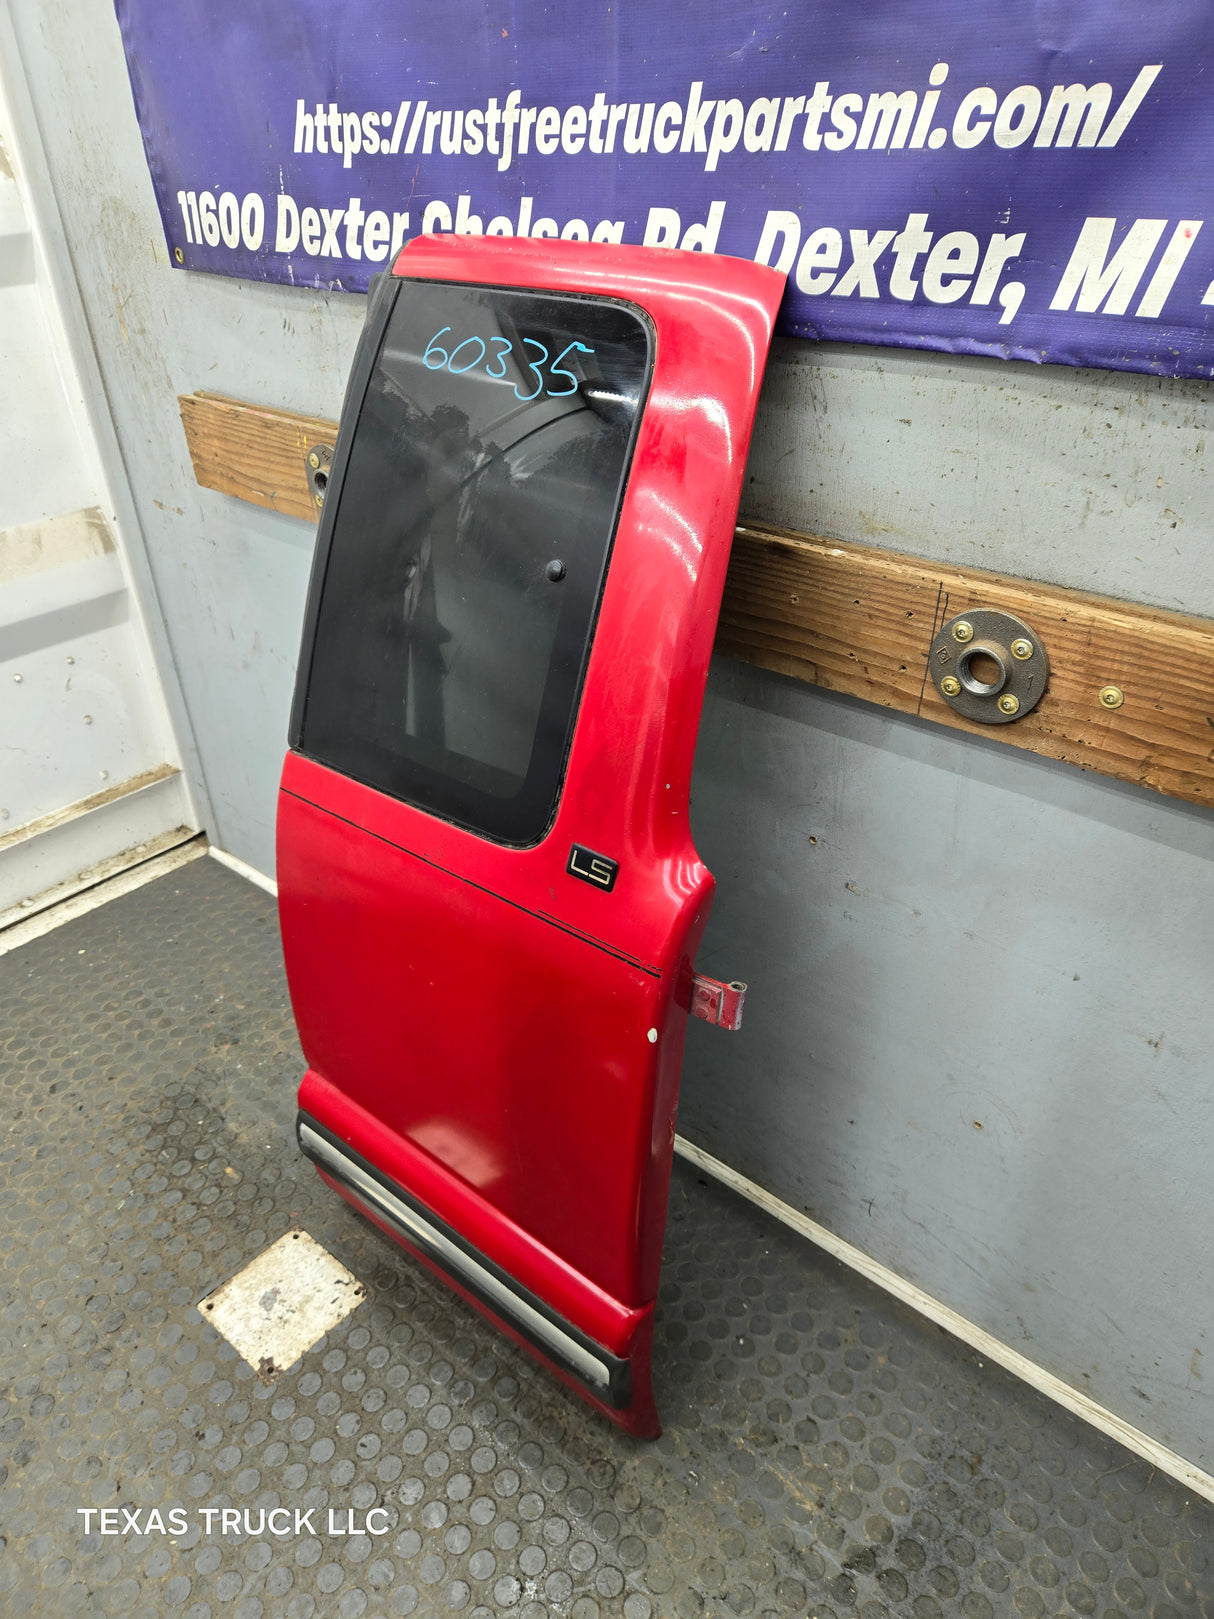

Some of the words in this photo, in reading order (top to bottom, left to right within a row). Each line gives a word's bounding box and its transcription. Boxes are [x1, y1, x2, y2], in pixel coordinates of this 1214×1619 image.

[294, 62, 1163, 172] https://rustfreetruckpartsmi.com/
[177, 190, 265, 251] 11600
[276, 194, 409, 262] Dexter
[753, 210, 1027, 325] Dexter,
[1049, 217, 1204, 318] MI
[423, 327, 595, 400] 60335
[570, 849, 611, 885] LS
